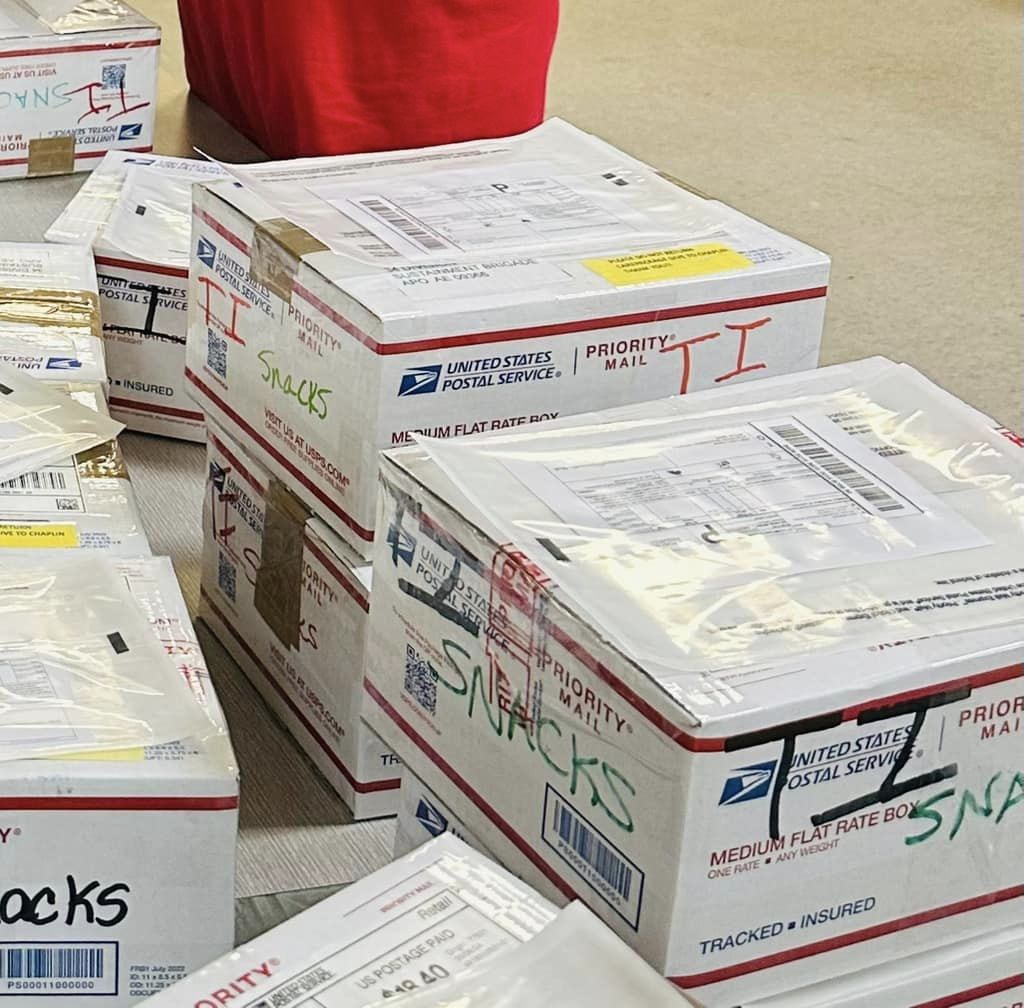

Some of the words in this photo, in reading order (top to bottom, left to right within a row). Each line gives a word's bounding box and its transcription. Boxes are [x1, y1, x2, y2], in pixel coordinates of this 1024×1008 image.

[12, 71, 21, 79] AT
[23, 70, 35, 78] US
[36, 69, 56, 77] VISIT
[86, 135, 116, 144] UNITED
[87, 126, 118, 134] POSTAL
[218, 252, 244, 278] UNITED
[99, 288, 139, 303] POSTAL
[142, 296, 189, 312] SRVICE
[215, 264, 241, 289] POSTAL
[239, 287, 272, 316] SERVICE
[288, 305, 338, 351] PRIORITY
[297, 329, 324, 357] MAIL
[586, 335, 669, 359] PRIORITY
[447, 357, 501, 374] UNITED
[502, 351, 551, 369] STATES
[605, 355, 648, 371] MAIL
[123, 379, 174, 397] INSURED
[442, 374, 494, 392] POSTAL
[497, 368, 554, 386] SERVICE
[264, 407, 282, 429] VISIT
[283, 423, 294, 440] US
[295, 435, 305, 448] AT
[454, 421, 488, 437] FLAT
[227, 479, 252, 509] UNITED
[420, 545, 466, 591] UNITD
[416, 563, 458, 606] POSAL
[542, 650, 628, 733] PRIORITY
[558, 690, 602, 735] MAIL
[958, 696, 1024, 727] PRIOR
[427, 638, 637, 833] SNACKS
[981, 717, 1020, 741] MAI
[789, 738, 845, 768] UNITED
[846, 725, 915, 755] STATES
[905, 772, 1024, 846] SNA
[710, 836, 786, 867] MEDIUM
[790, 823, 829, 847] FLAT
[836, 811, 880, 836] RATE
[883, 798, 920, 824] BOX
[707, 867, 732, 880] ONE
[734, 859, 761, 874] RATE
[776, 849, 798, 864] ANY
[800, 838, 841, 858] WEIGHT
[417, 896, 454, 921] Retail
[699, 921, 784, 955] TRACKED
[800, 897, 876, 929] INSURED
[355, 975, 376, 990] US
[373, 944, 427, 980] POSTAGE
[426, 928, 456, 949] PAID
